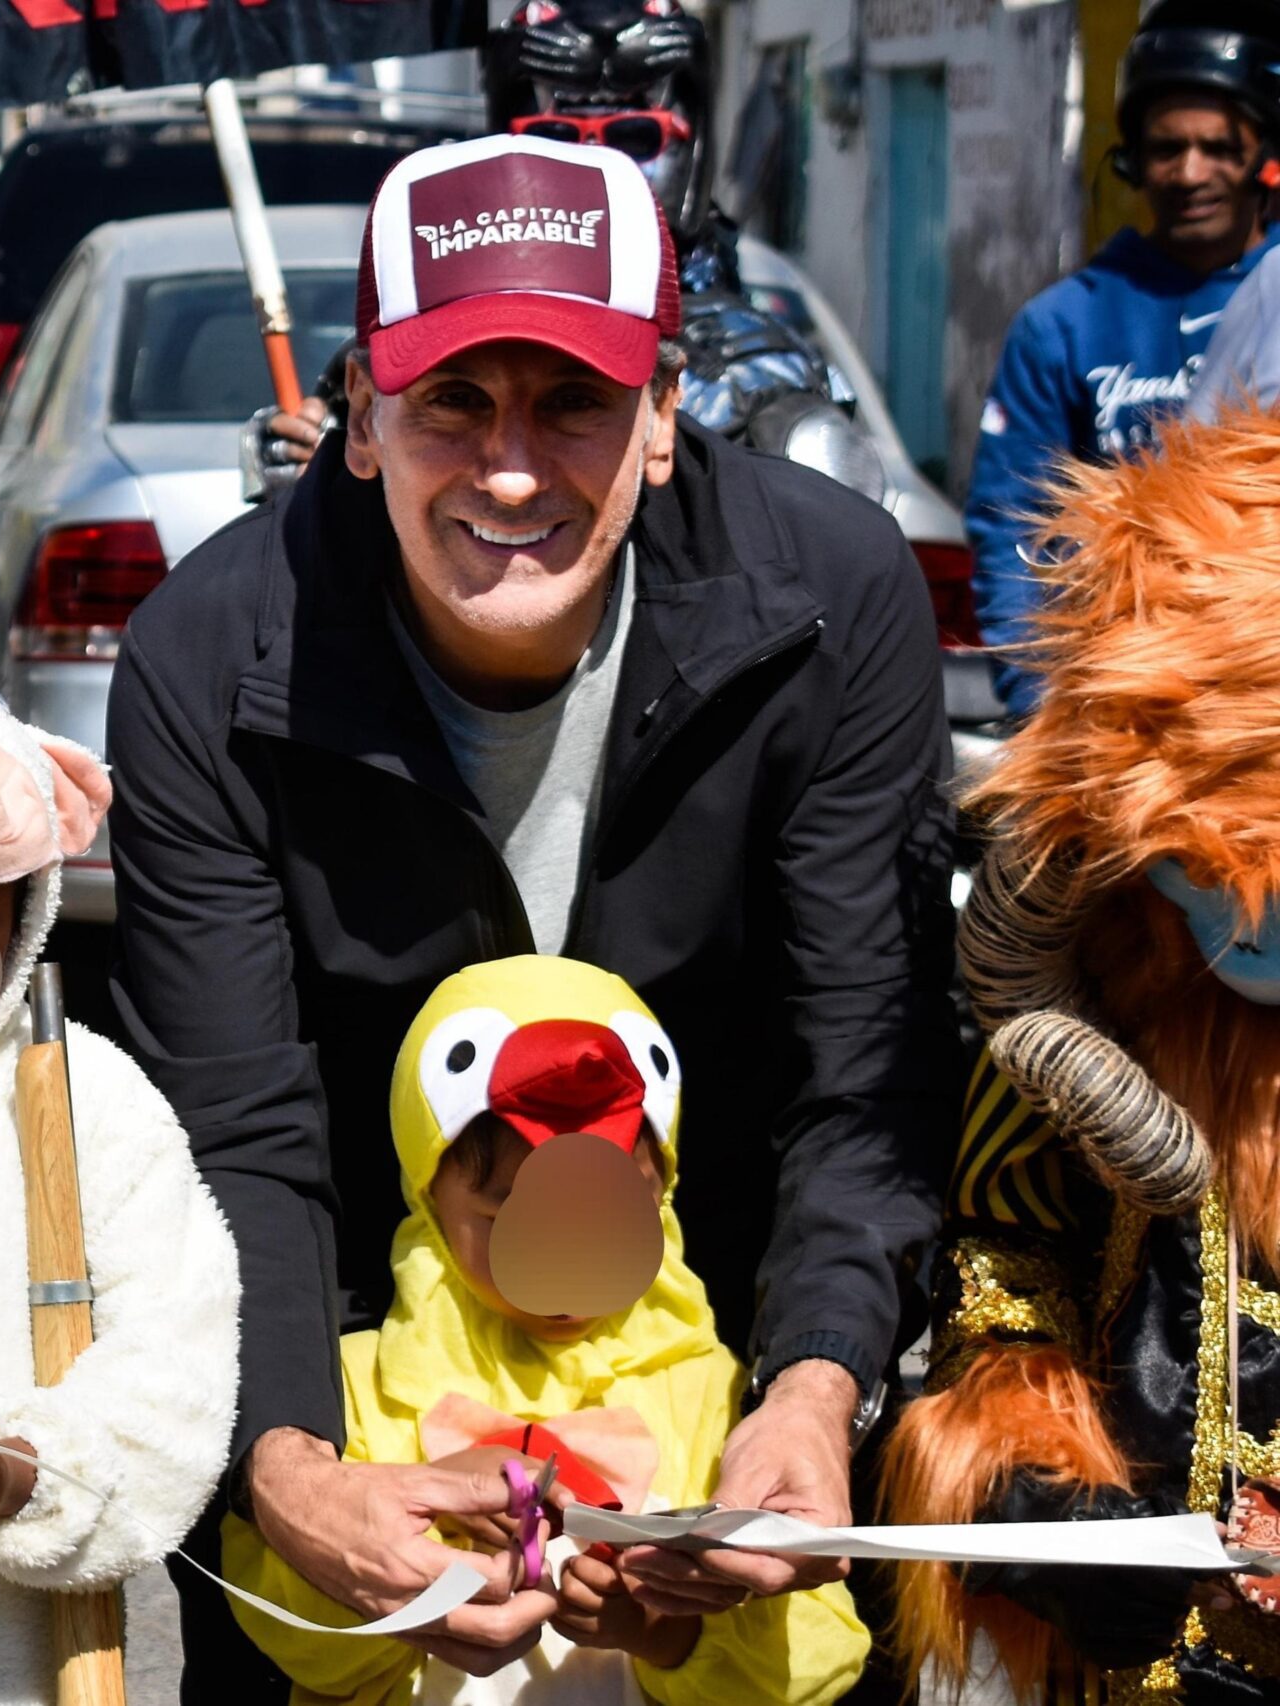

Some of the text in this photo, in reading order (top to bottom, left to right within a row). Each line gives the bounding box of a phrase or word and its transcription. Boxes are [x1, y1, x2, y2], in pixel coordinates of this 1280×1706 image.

[439, 207, 582, 236] LA CAPITAL
[430, 221, 597, 260] IMPARABLE
